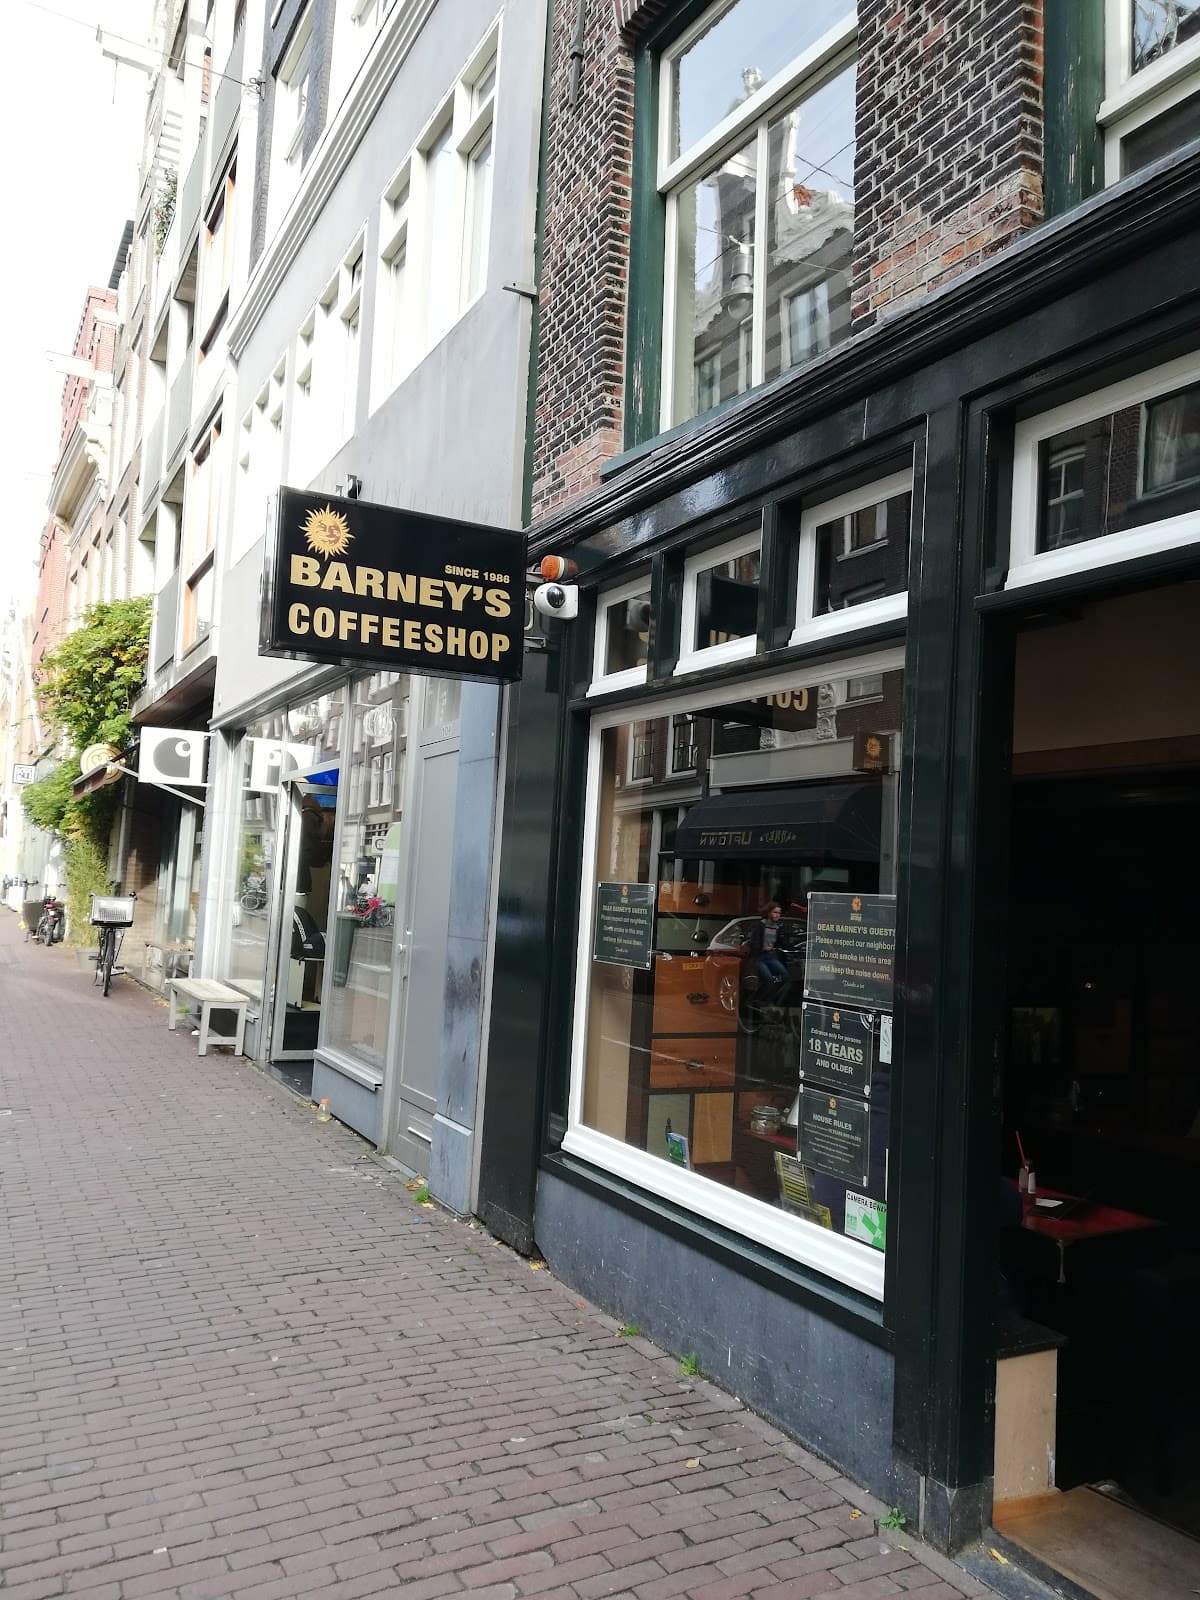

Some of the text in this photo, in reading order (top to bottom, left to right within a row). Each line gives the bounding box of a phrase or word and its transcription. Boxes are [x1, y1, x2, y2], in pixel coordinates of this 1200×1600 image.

[445, 564, 510, 584] SINCE 1986
[290, 554, 511, 618] BARNEY'S
[288, 603, 510, 662] COFFEESHOP
[817, 923, 835, 932] DEAR
[836, 925, 868, 935] BARNEY'S
[816, 936, 833, 945] Please
[834, 938, 854, 948] respect
[820, 950, 828, 958] Do
[840, 953, 857, 962] smoke
[859, 954, 864, 962] in
[865, 955, 876, 964] this
[878, 958, 891, 966] area
[831, 966, 844, 975] keep
[845, 967, 854, 975] the
[855, 969, 871, 978] noise
[872, 971, 891, 981] down.
[810, 1027, 828, 1037] Entrance
[829, 1032, 837, 1040] only
[844, 1036, 862, 1045] persons
[808, 1037, 864, 1063] 18 YEARS
[816, 1058, 854, 1075] AND OLDER
[813, 1113, 833, 1125] HOUSE
[833, 1119, 852, 1131] RULES
[847, 1193, 868, 1207] CAMERA
